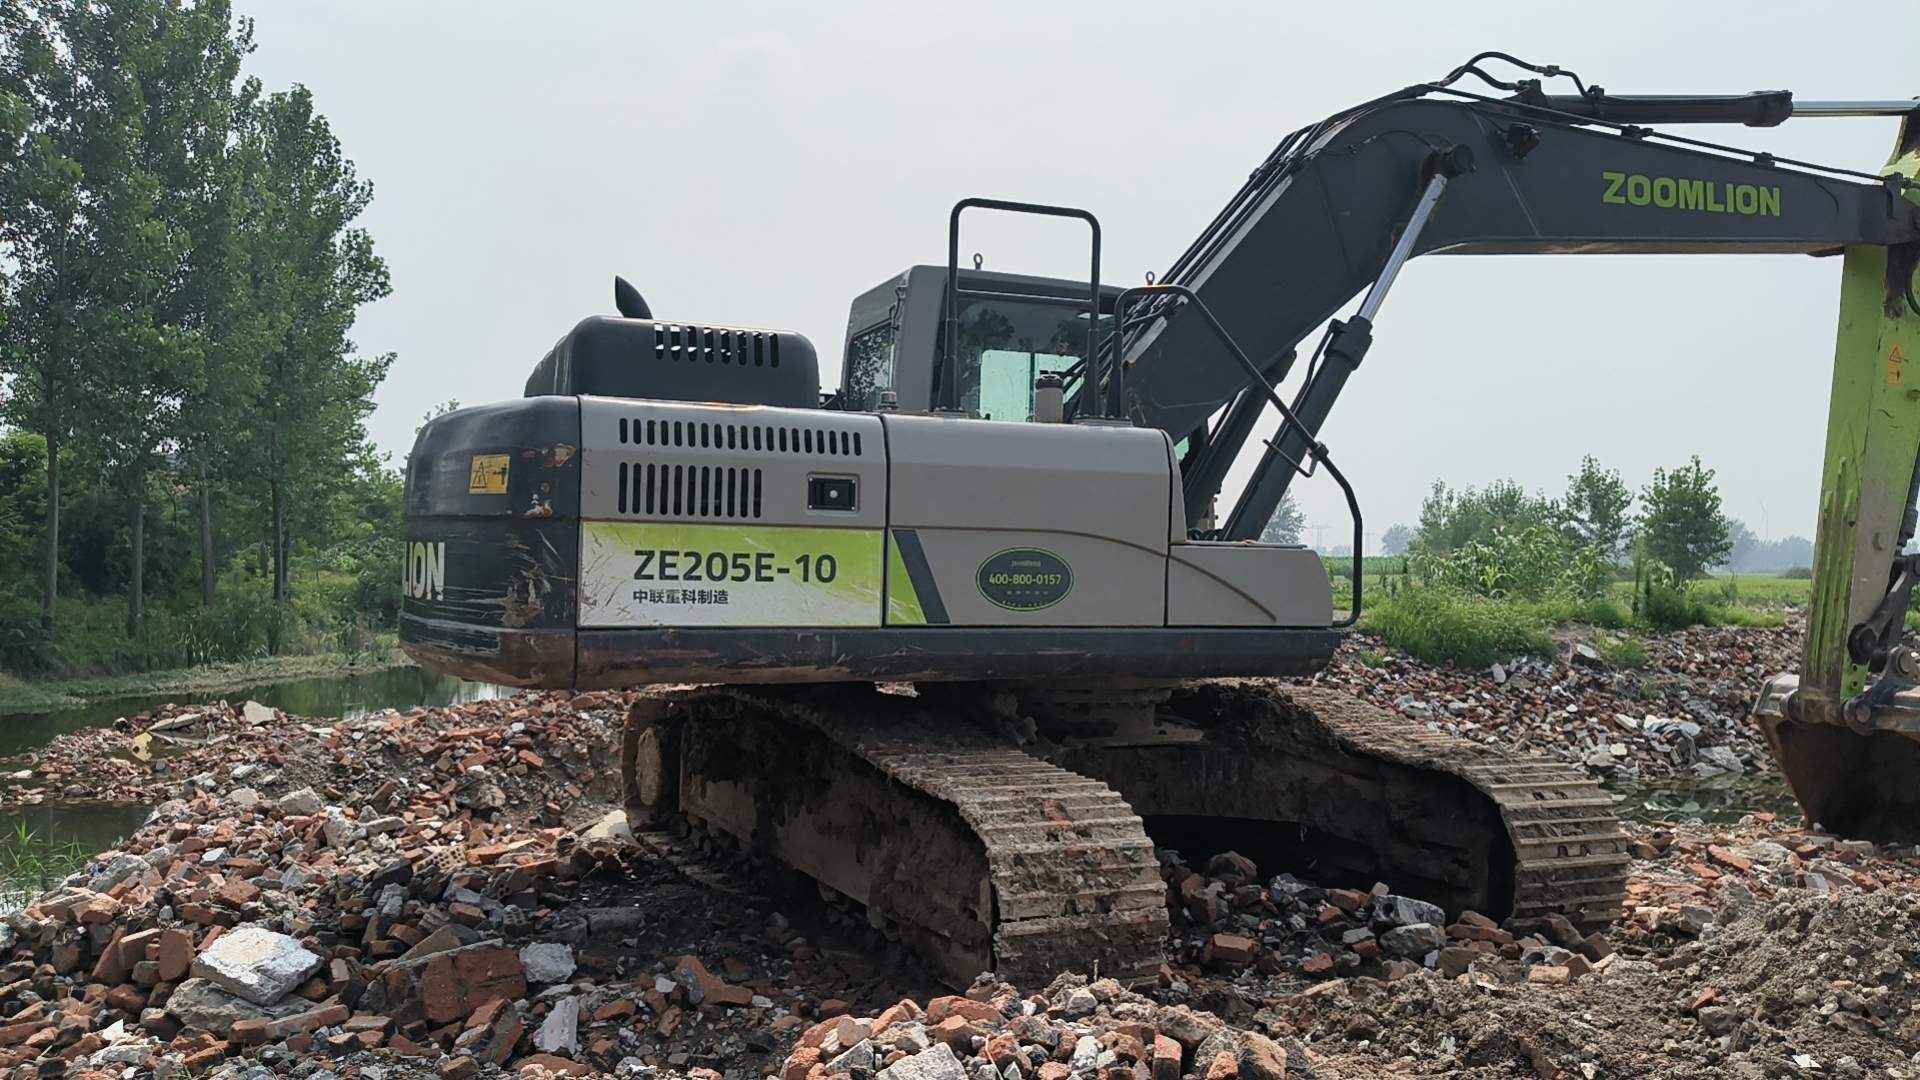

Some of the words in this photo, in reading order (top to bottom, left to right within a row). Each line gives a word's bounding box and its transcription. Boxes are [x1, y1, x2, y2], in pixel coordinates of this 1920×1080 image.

[1602, 171, 1781, 217] ZOOMLION
[633, 550, 837, 583] ZE205E-10
[989, 574, 1062, 585] 400-800-0157
